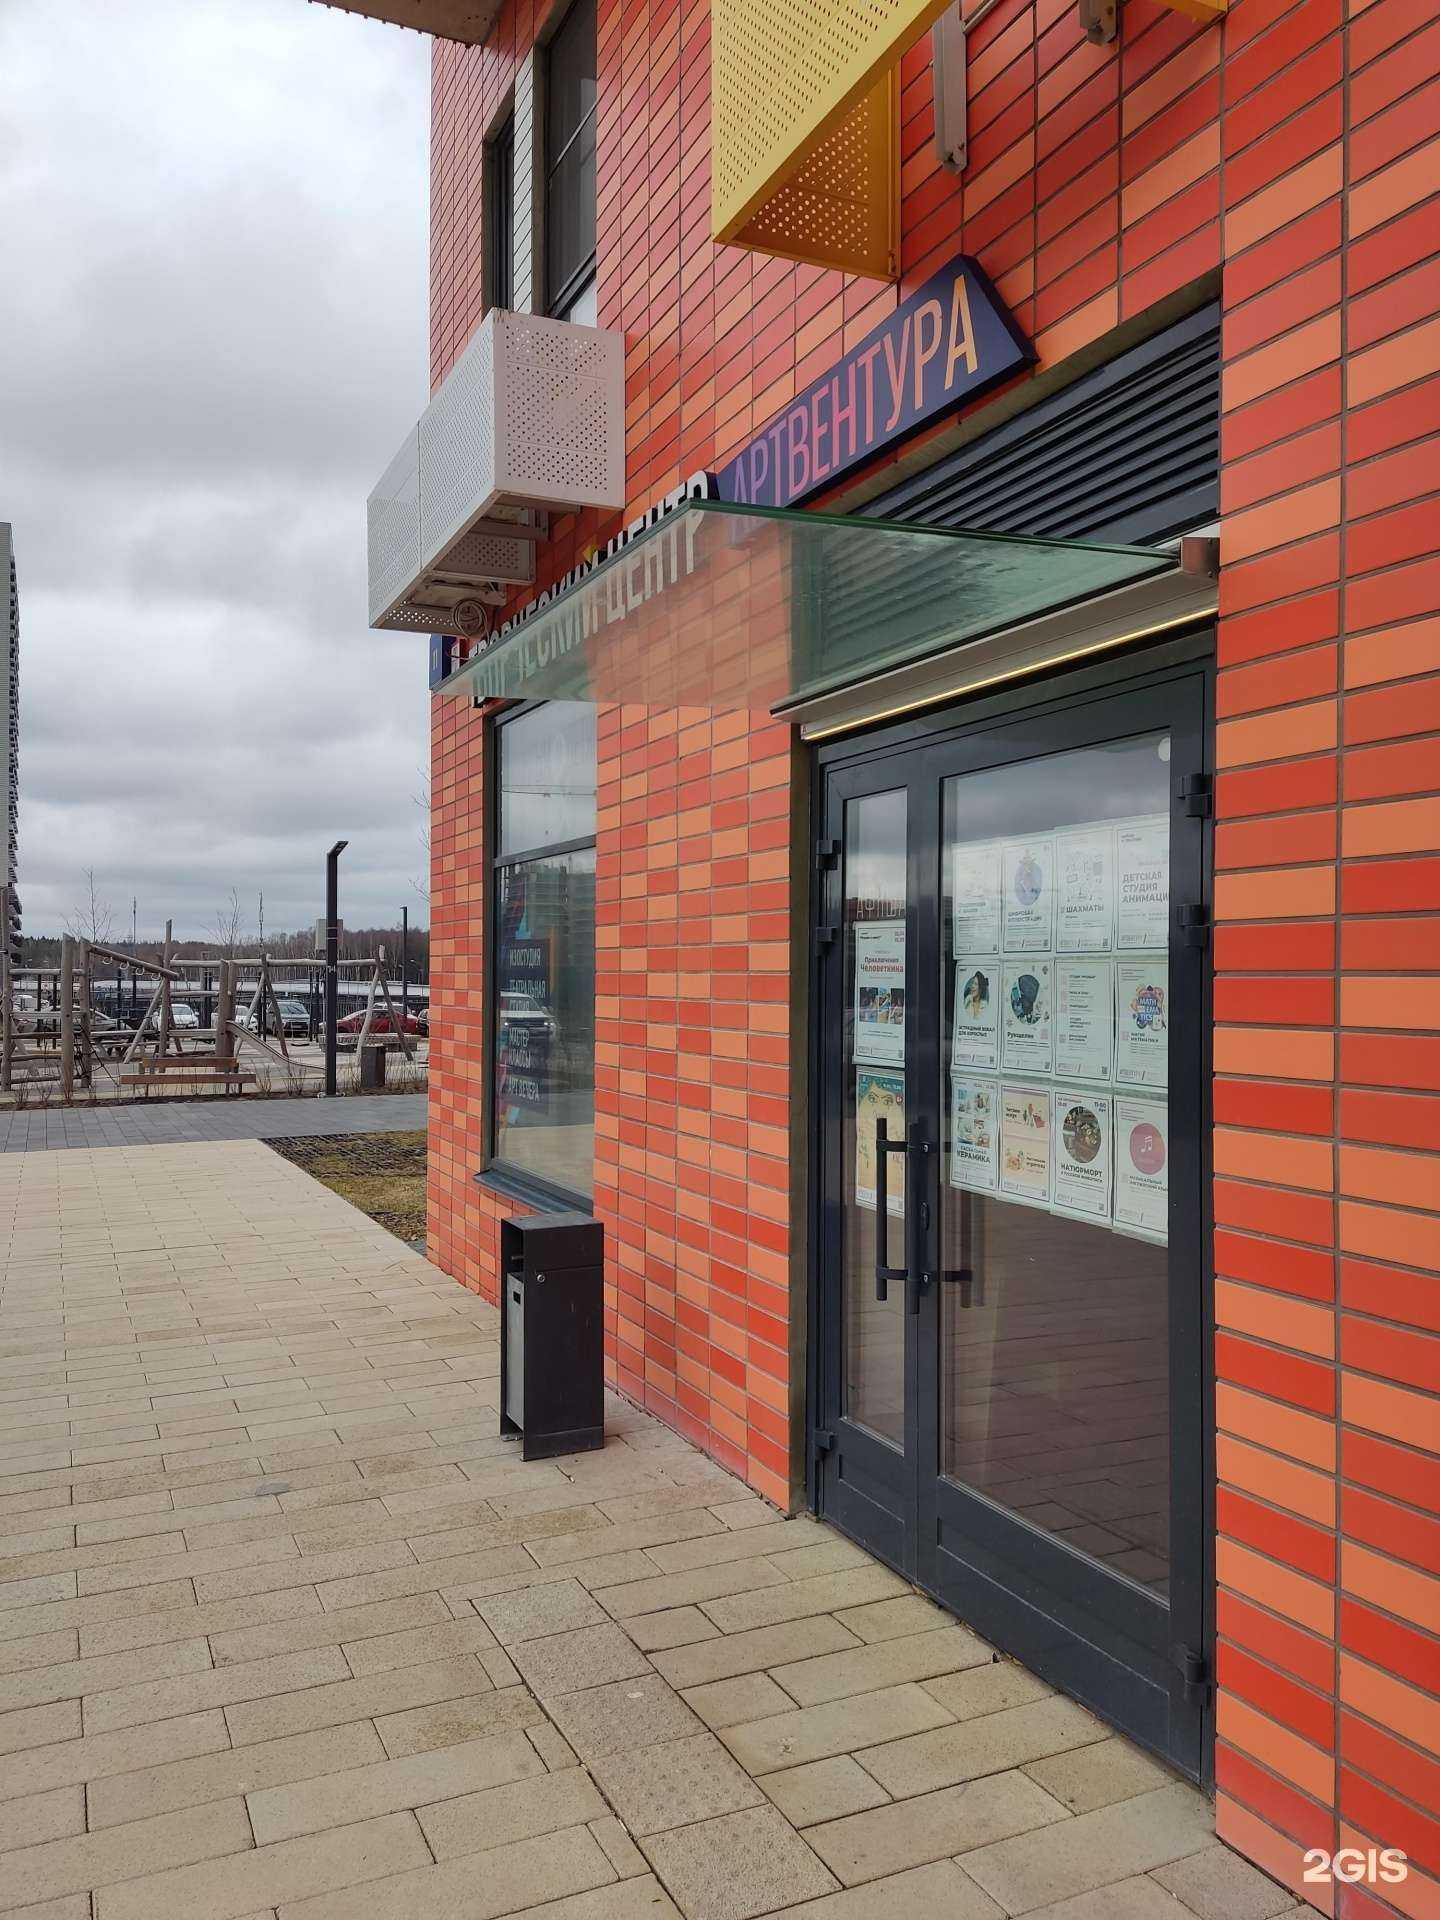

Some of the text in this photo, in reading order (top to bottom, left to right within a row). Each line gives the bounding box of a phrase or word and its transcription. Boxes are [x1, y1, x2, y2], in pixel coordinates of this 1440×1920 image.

[732, 274, 978, 546] АРТВЕНТУРА
[606, 470, 709, 625] ЦЕНТР
[1123, 872, 1162, 883] ДЕТСКАЯ
[1123, 883, 1158, 893] СТУДИЯ
[1066, 904, 1104, 913] ШАХМАТЫ
[509, 948, 541, 968] ИЗОСТУДИЯ
[509, 979, 546, 998] ТЕАТРАЛЬНАЯ
[509, 1027, 530, 1047] МАСТЕР
[957, 1150, 991, 1163] КЕРАМИКА
[1061, 1163, 1103, 1177] НАТЮРМОРТ
